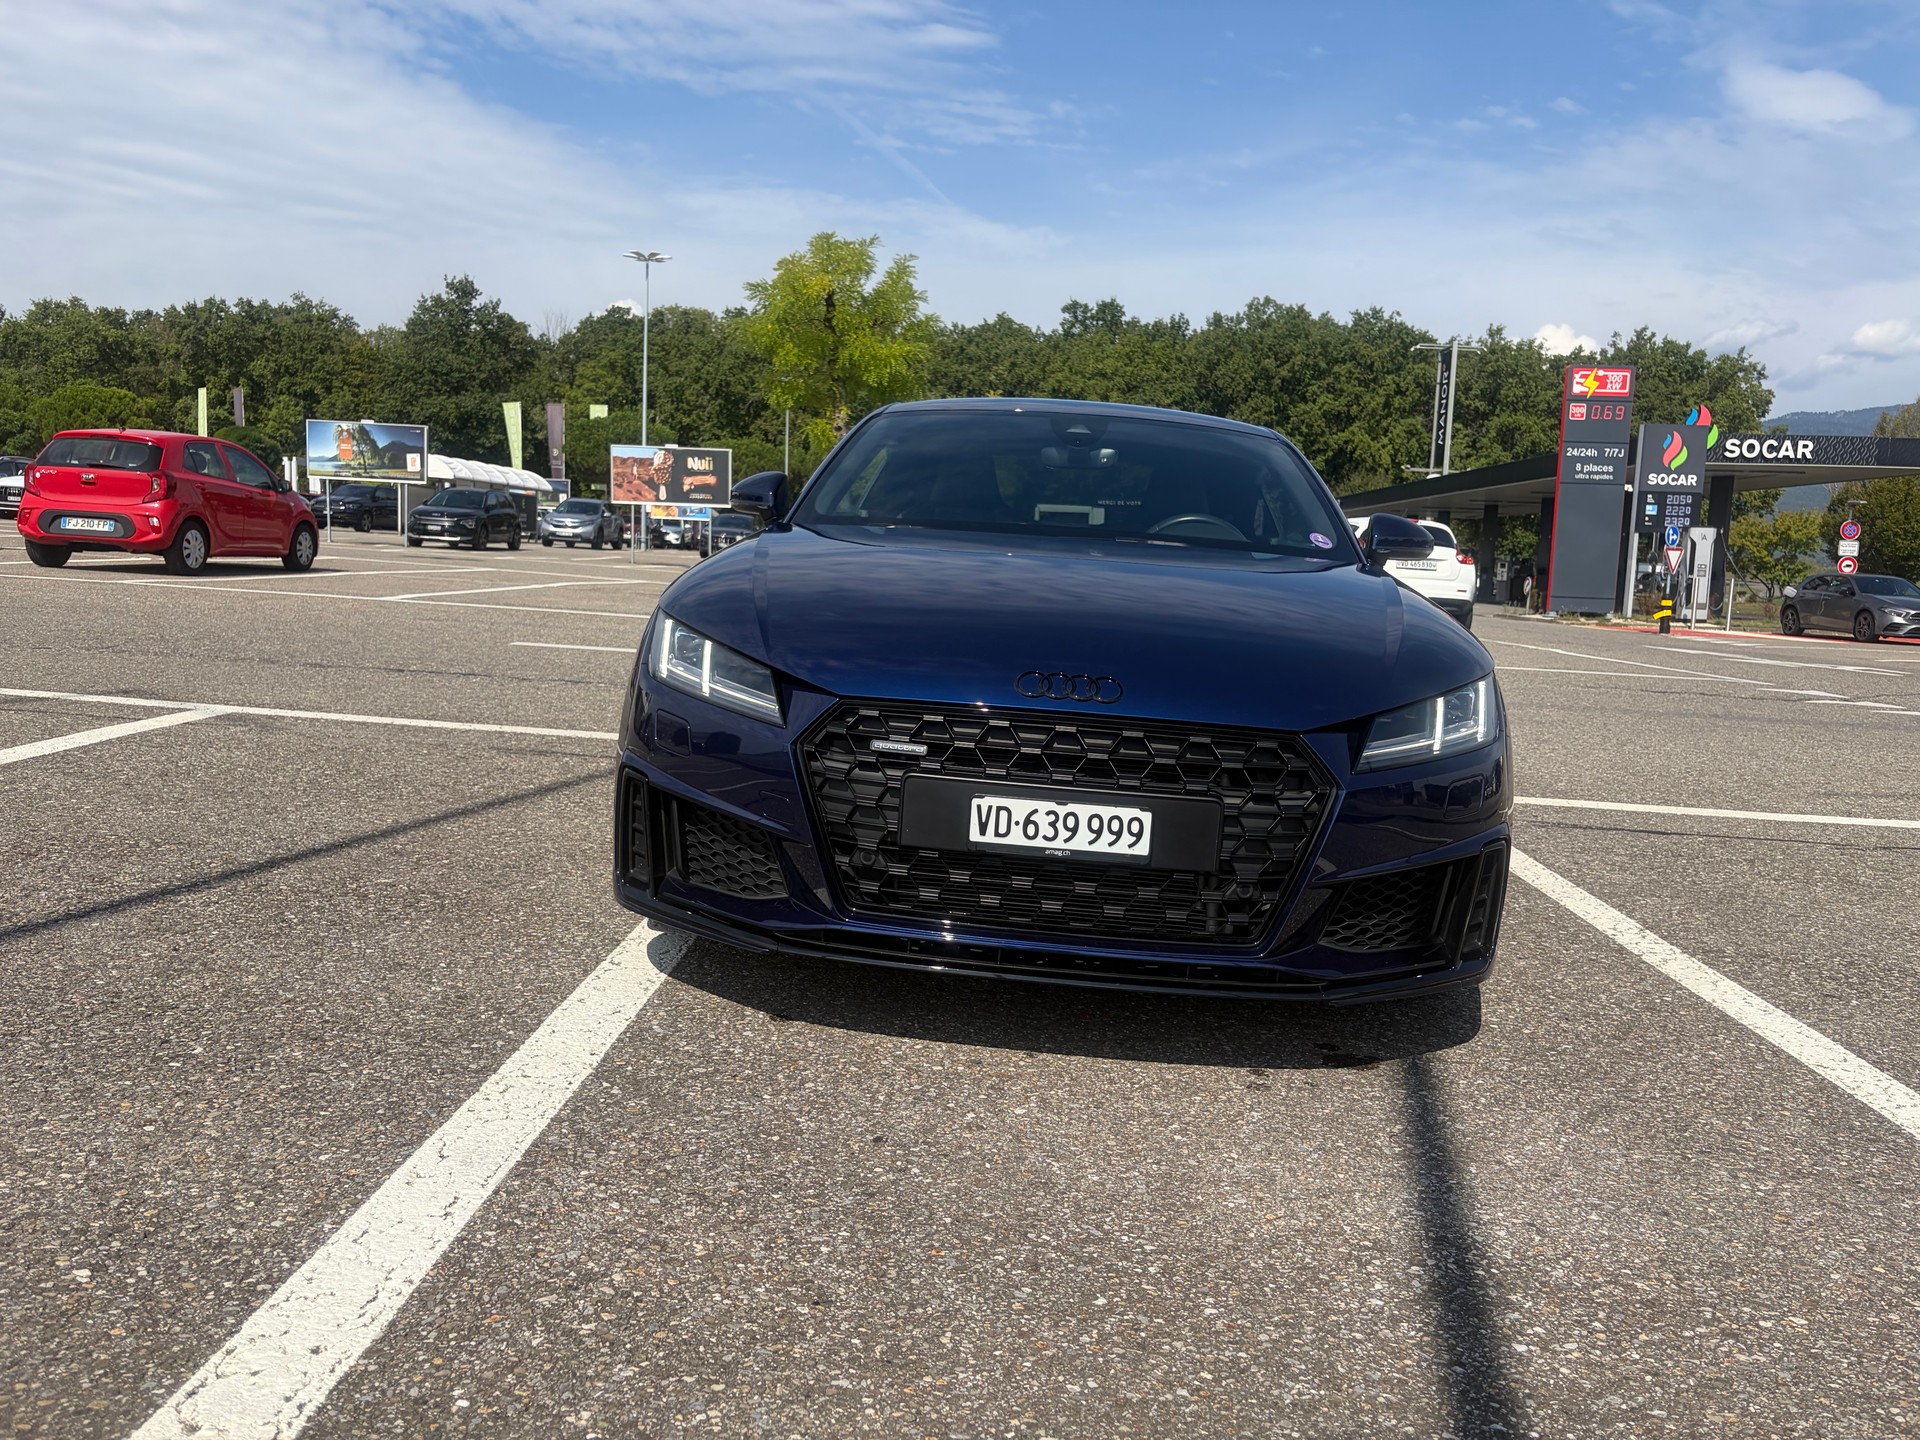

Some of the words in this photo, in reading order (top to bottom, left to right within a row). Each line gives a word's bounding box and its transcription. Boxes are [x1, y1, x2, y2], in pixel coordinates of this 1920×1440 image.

[1606, 374, 1623, 382] 300
[1606, 382, 1622, 390] kW
[1437, 371, 1449, 445] MANOR
[1591, 404, 1625, 420] 0.69
[1566, 447, 1598, 457] 24/24h
[1604, 448, 1625, 457] 7/7J
[1724, 438, 1814, 459] SOCAR
[1575, 463, 1582, 472] 8
[1583, 463, 1614, 473] places
[1647, 473, 1697, 486] SOCAR
[874, 742, 924, 752] quattro
[1044, 849, 1071, 857] amag.ch
